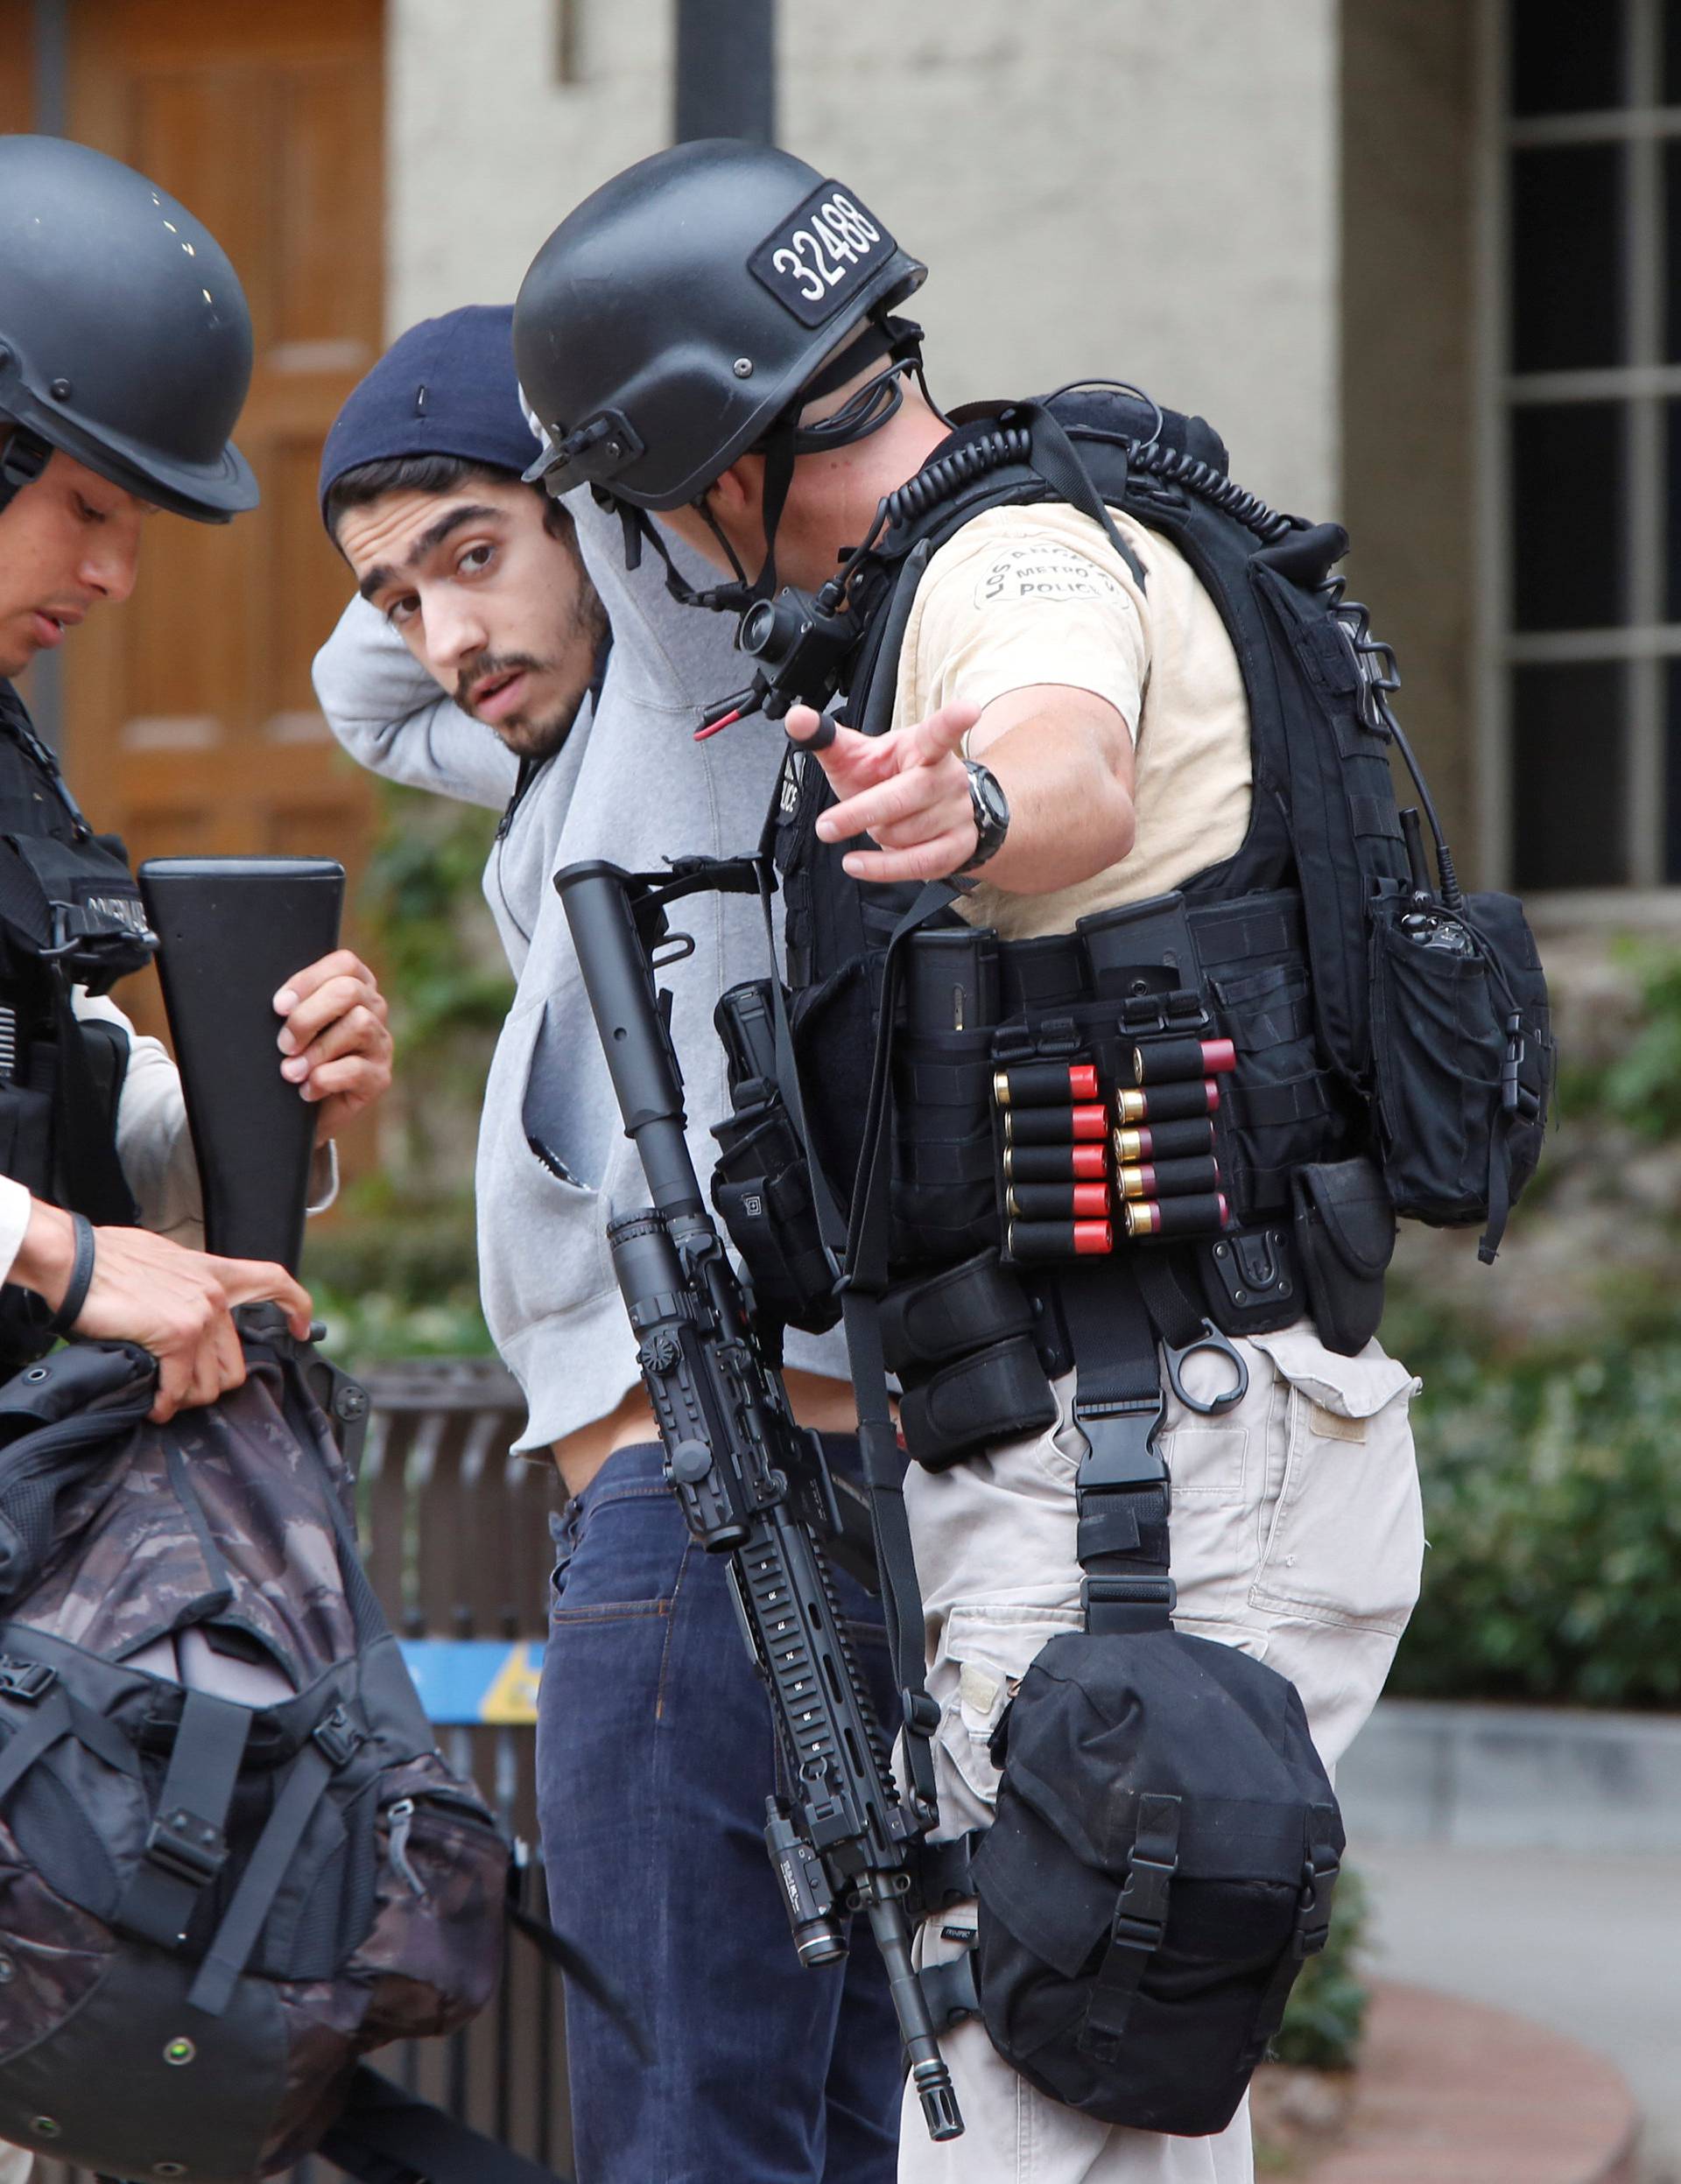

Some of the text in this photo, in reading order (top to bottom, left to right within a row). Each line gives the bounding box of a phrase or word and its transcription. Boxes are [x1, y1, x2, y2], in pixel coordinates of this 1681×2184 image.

[772, 193, 881, 301] 32488
[986, 564, 1011, 600] LOS
[1016, 566, 1089, 579] METRO
[1020, 583, 1101, 596] POLICE
